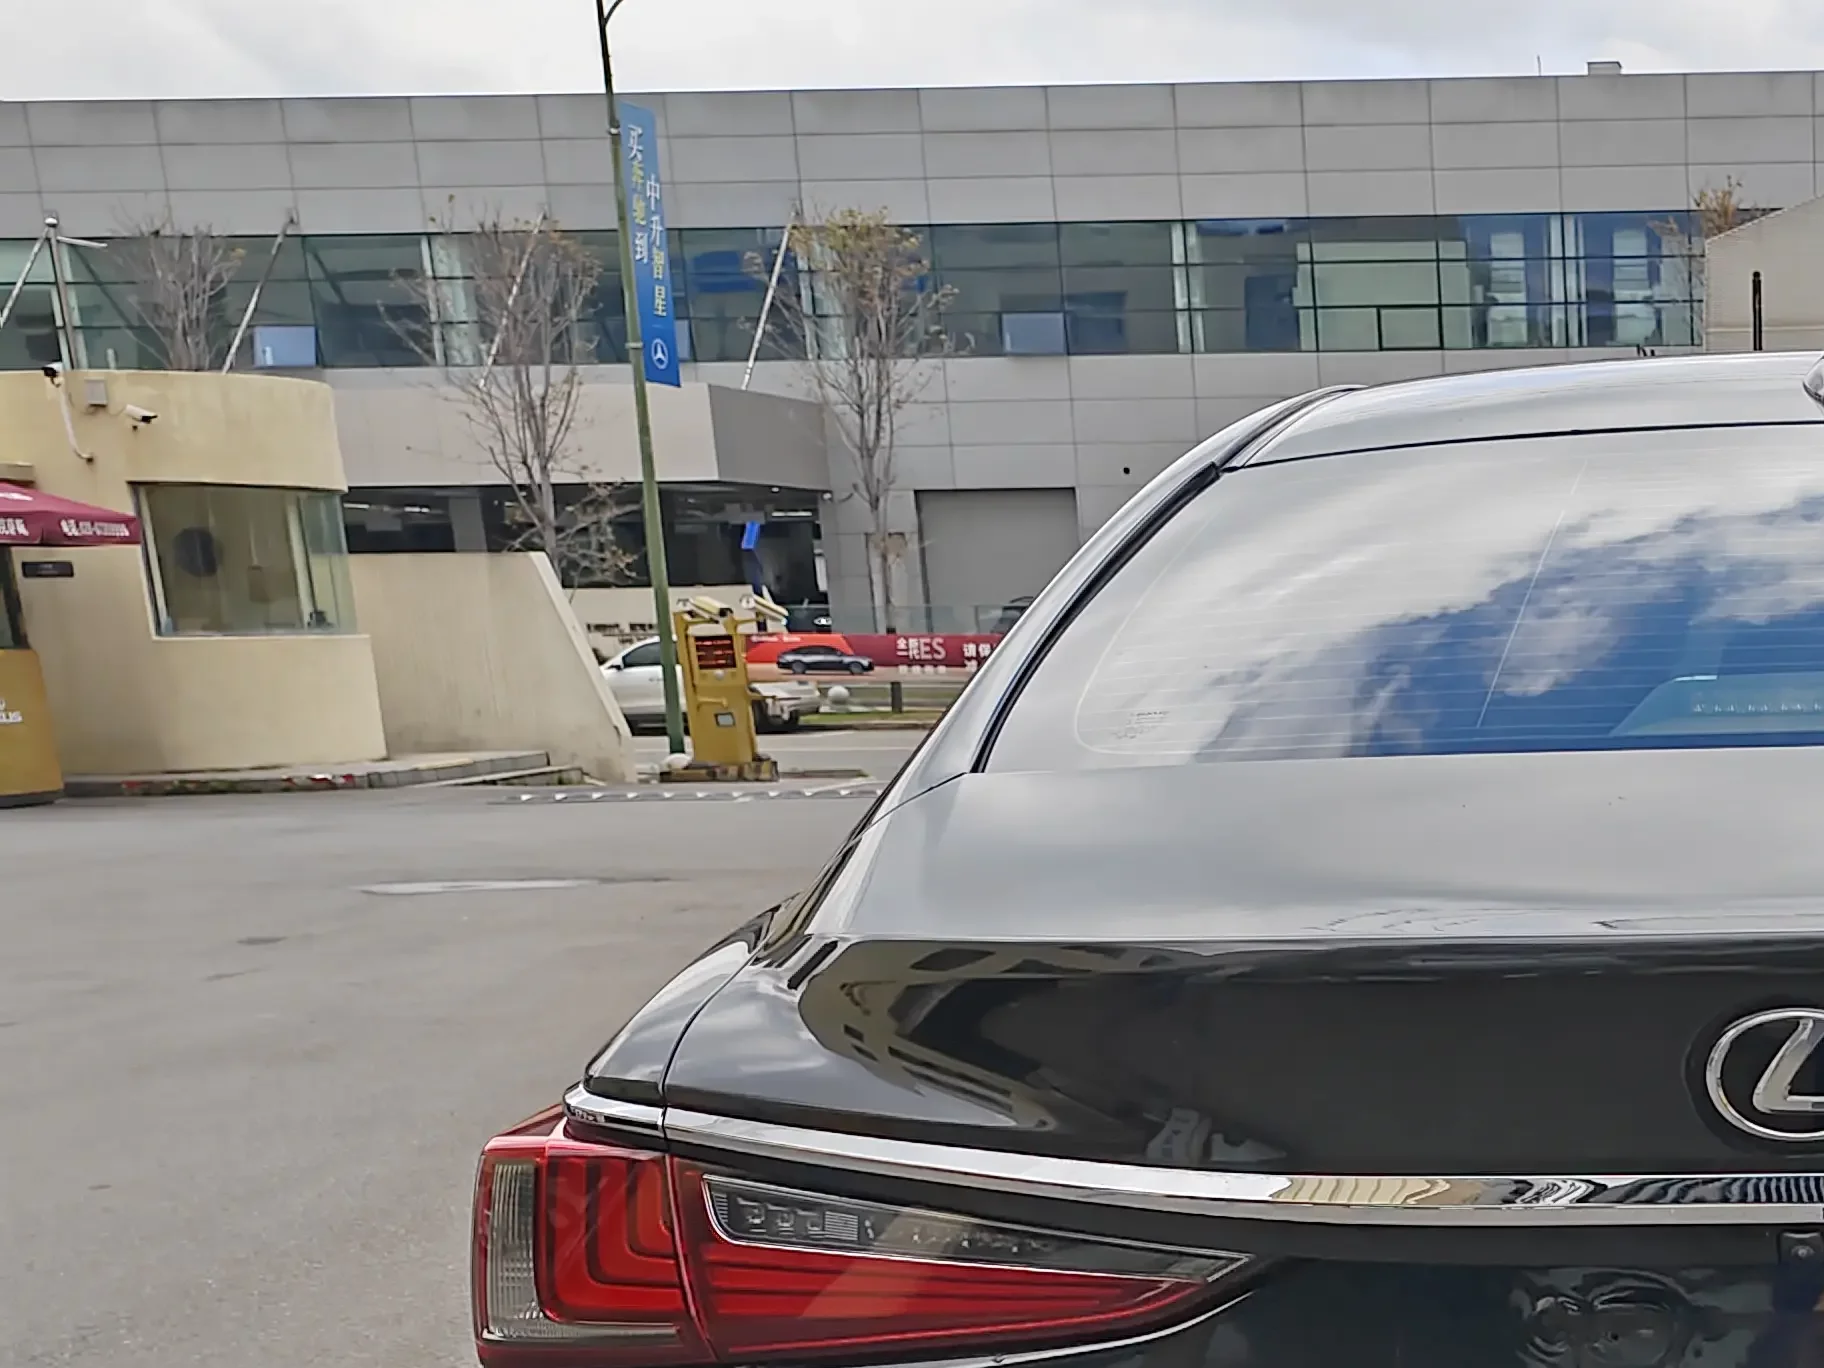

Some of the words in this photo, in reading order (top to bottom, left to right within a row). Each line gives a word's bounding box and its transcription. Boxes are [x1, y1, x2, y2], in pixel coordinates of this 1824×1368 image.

[627, 124, 648, 264] 买奔驰到
[646, 173, 667, 317] 中升智星
[920, 637, 947, 660] ES
